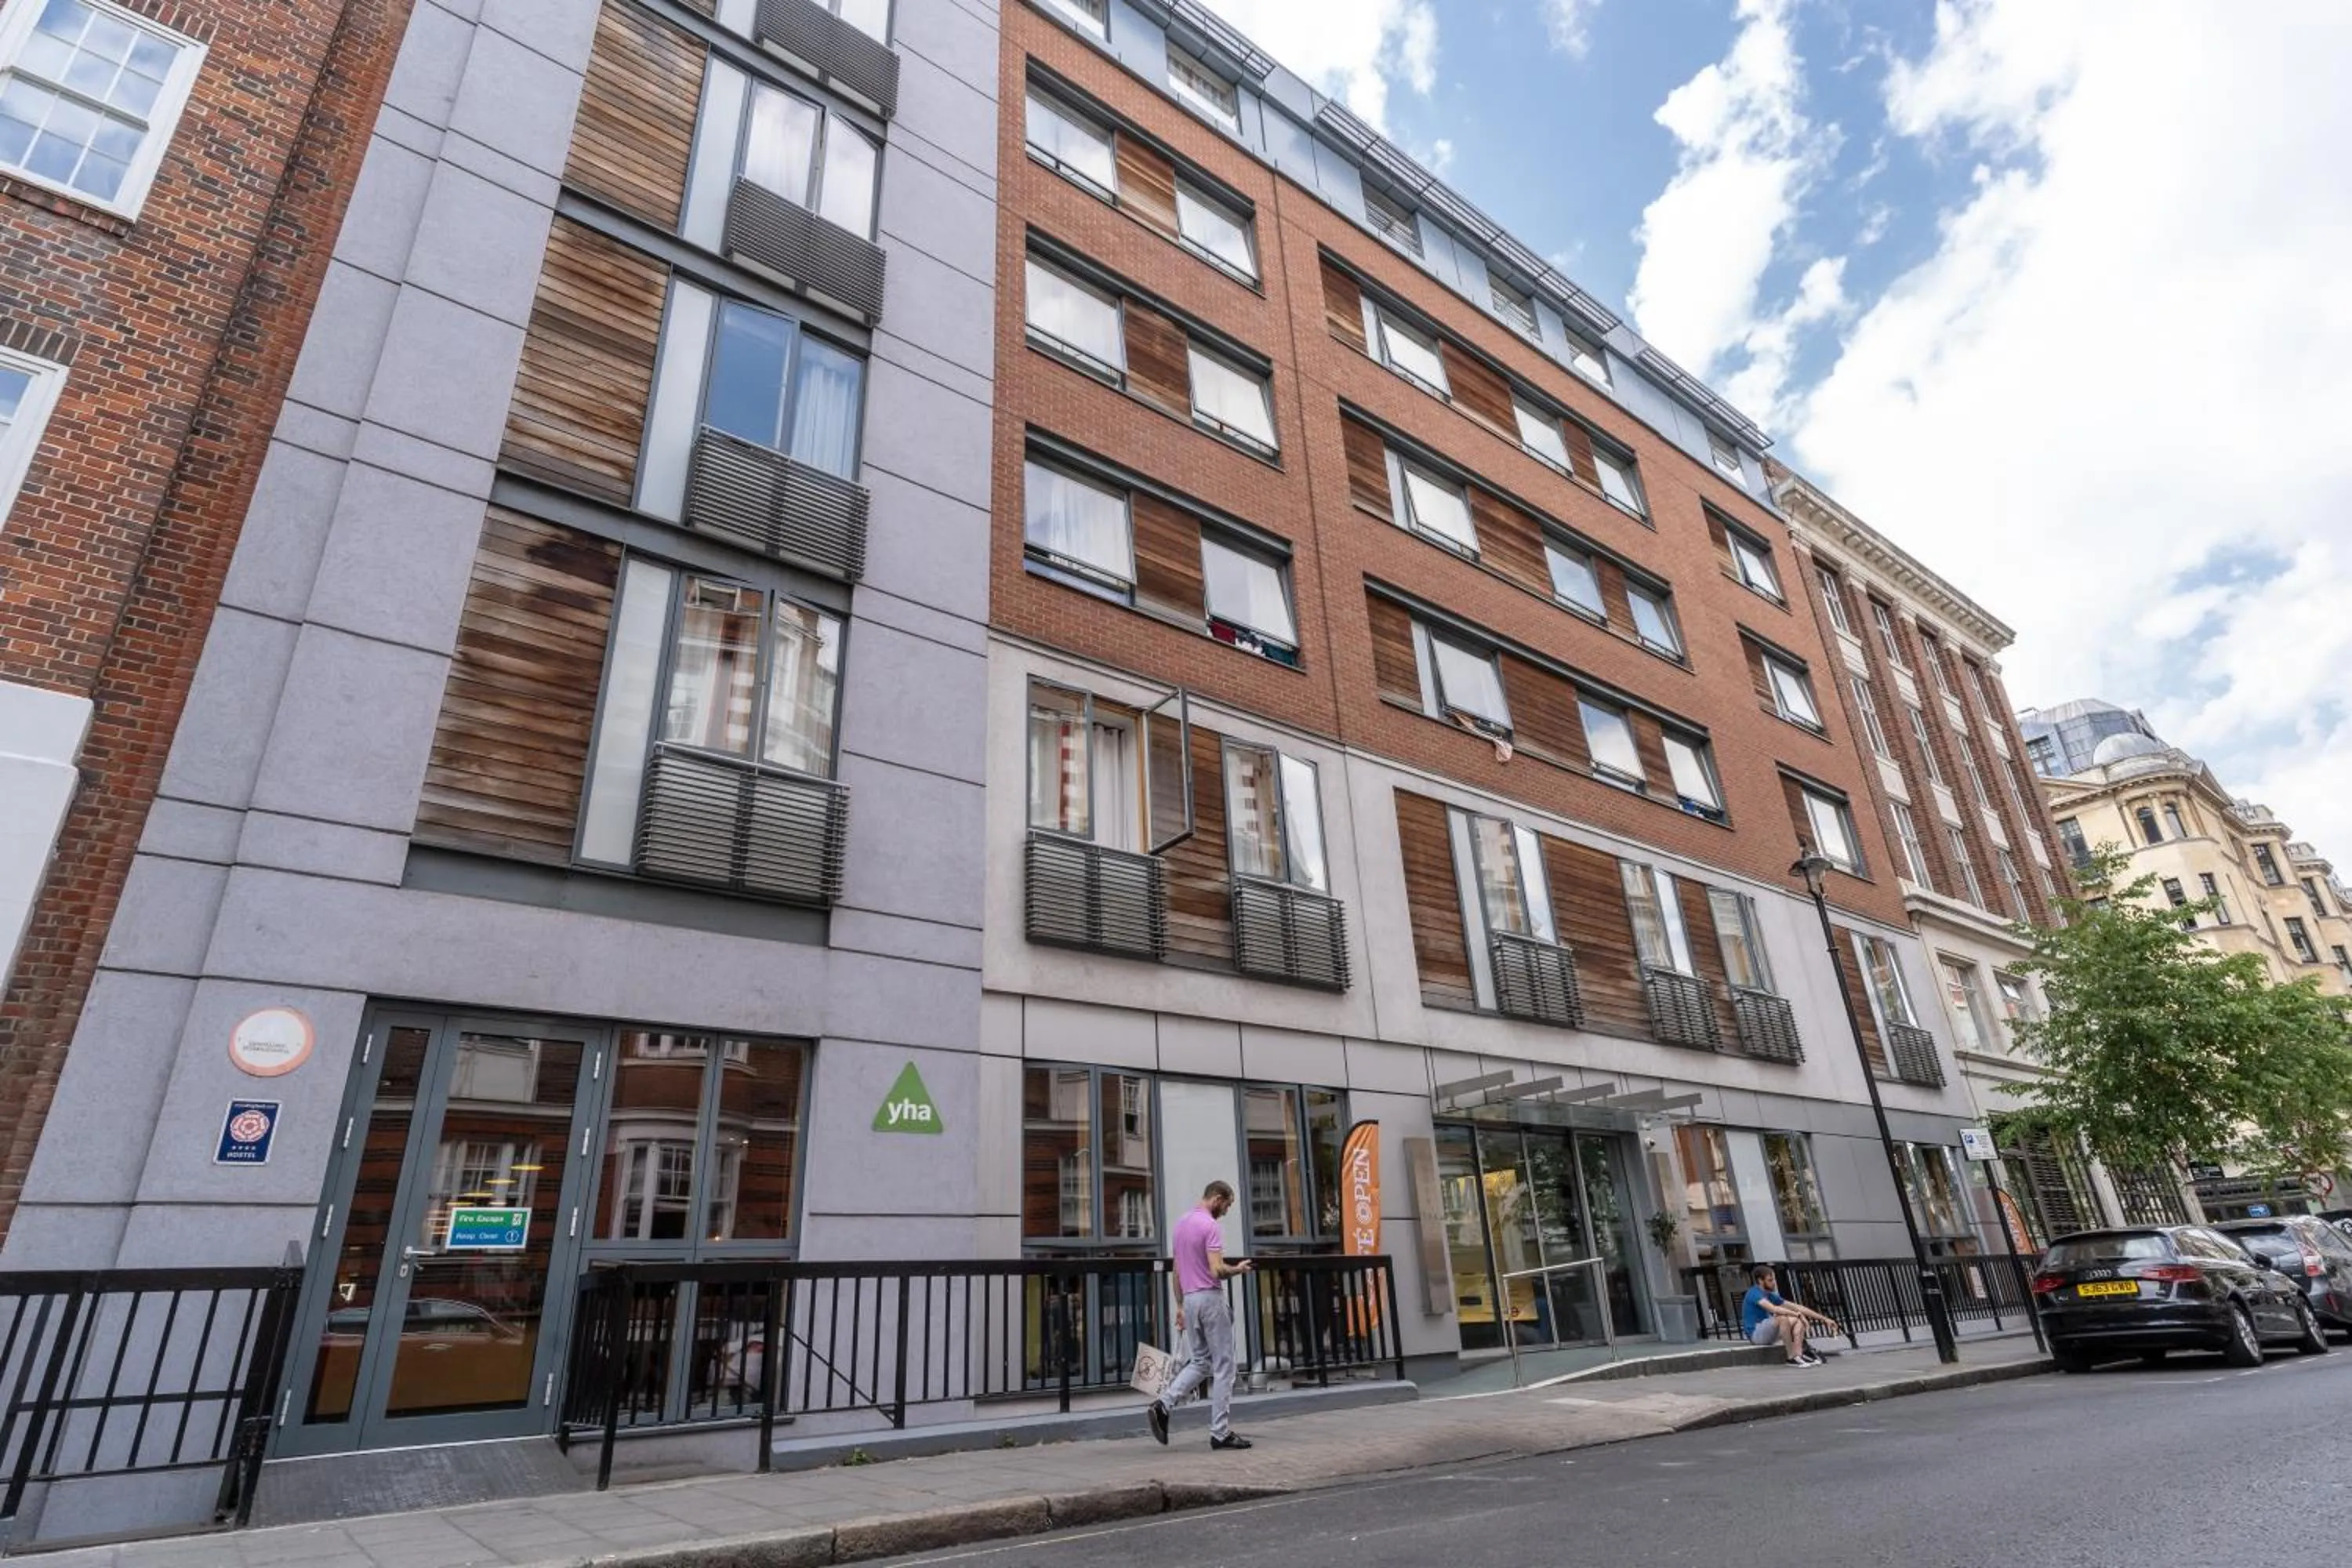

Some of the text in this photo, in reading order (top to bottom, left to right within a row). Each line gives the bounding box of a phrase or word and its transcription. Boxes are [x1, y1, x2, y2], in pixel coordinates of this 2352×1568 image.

[887, 1098, 931, 1125] yha
[1352, 1147, 1373, 1224] OPEN
[476, 1214, 504, 1223] Escape
